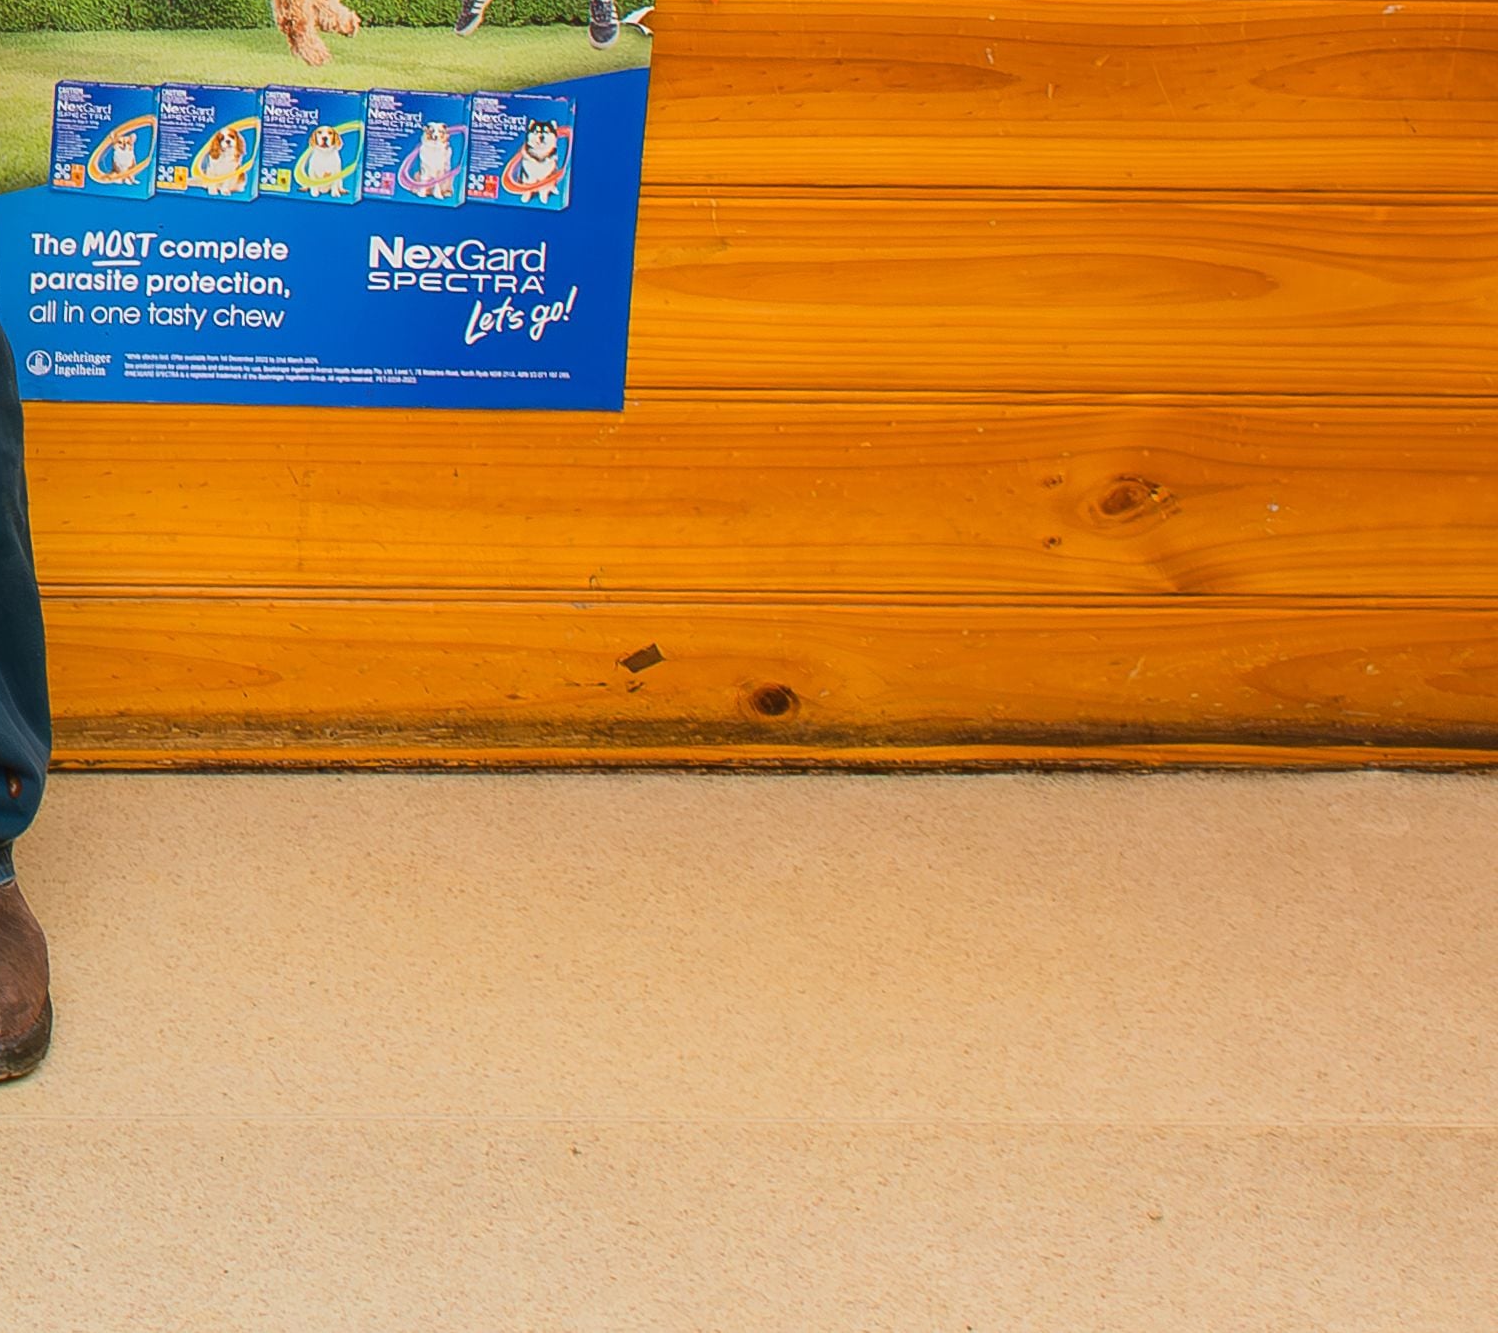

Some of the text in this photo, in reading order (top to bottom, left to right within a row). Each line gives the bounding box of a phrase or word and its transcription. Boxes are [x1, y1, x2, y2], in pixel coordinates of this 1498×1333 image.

[57, 100, 111, 114] NexGard
[160, 103, 215, 117] NexGard
[263, 105, 319, 119] NexGard
[367, 108, 423, 122] NexGard
[471, 110, 527, 124] NexGard
[31, 230, 289, 263] The MOST complete
[368, 235, 547, 273] NexGard
[30, 269, 291, 299] parasite protection,
[367, 272, 545, 295] SPECTRA
[29, 300, 285, 330] all in one tasty chew
[465, 285, 578, 345] Let's go!
[55, 351, 113, 365] Boehringer
[55, 364, 106, 377] Ingelheim
